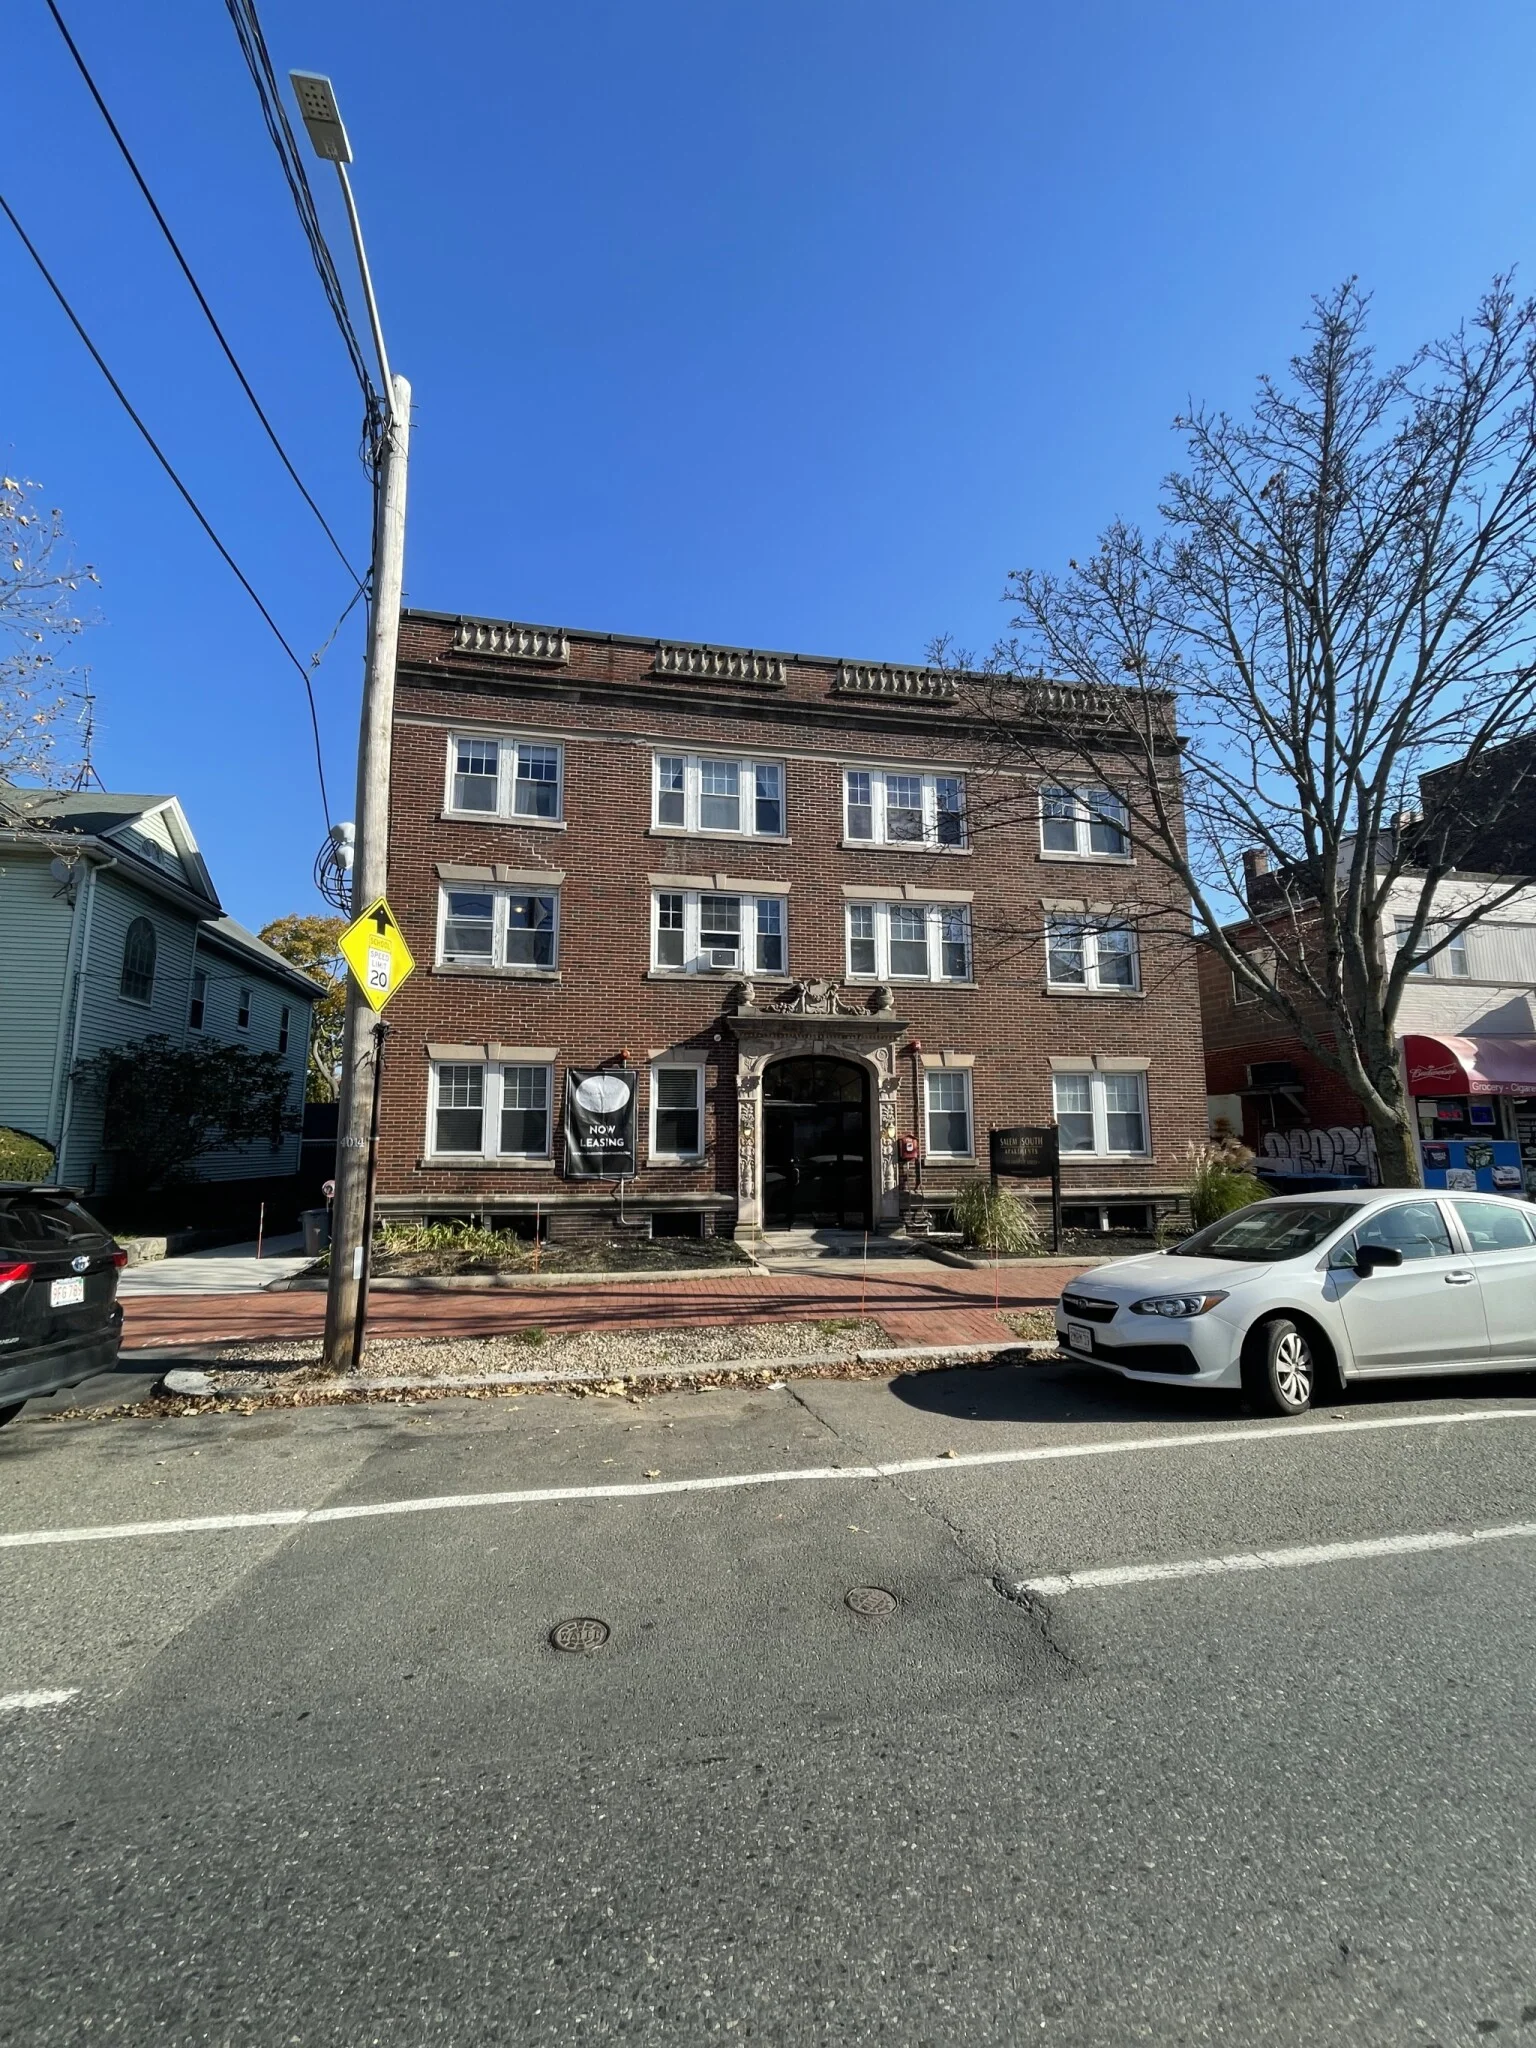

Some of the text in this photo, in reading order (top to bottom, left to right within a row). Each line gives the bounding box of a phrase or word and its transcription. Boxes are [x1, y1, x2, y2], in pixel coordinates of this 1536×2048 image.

[370, 937, 391, 950] SCHOOL
[370, 950, 390, 962] SPEED
[371, 960, 387, 970] LIMIT
[370, 969, 388, 988] 20
[1409, 1068, 1457, 1078] Budweiser
[1472, 1081, 1504, 1093] Grocery
[589, 1125, 616, 1135] NOW
[340, 1137, 365, 1148] 4014
[580, 1138, 625, 1148] LEASING
[999, 1136, 1043, 1146] SALEM SOUTH
[560, 1630, 601, 1641] WATER
